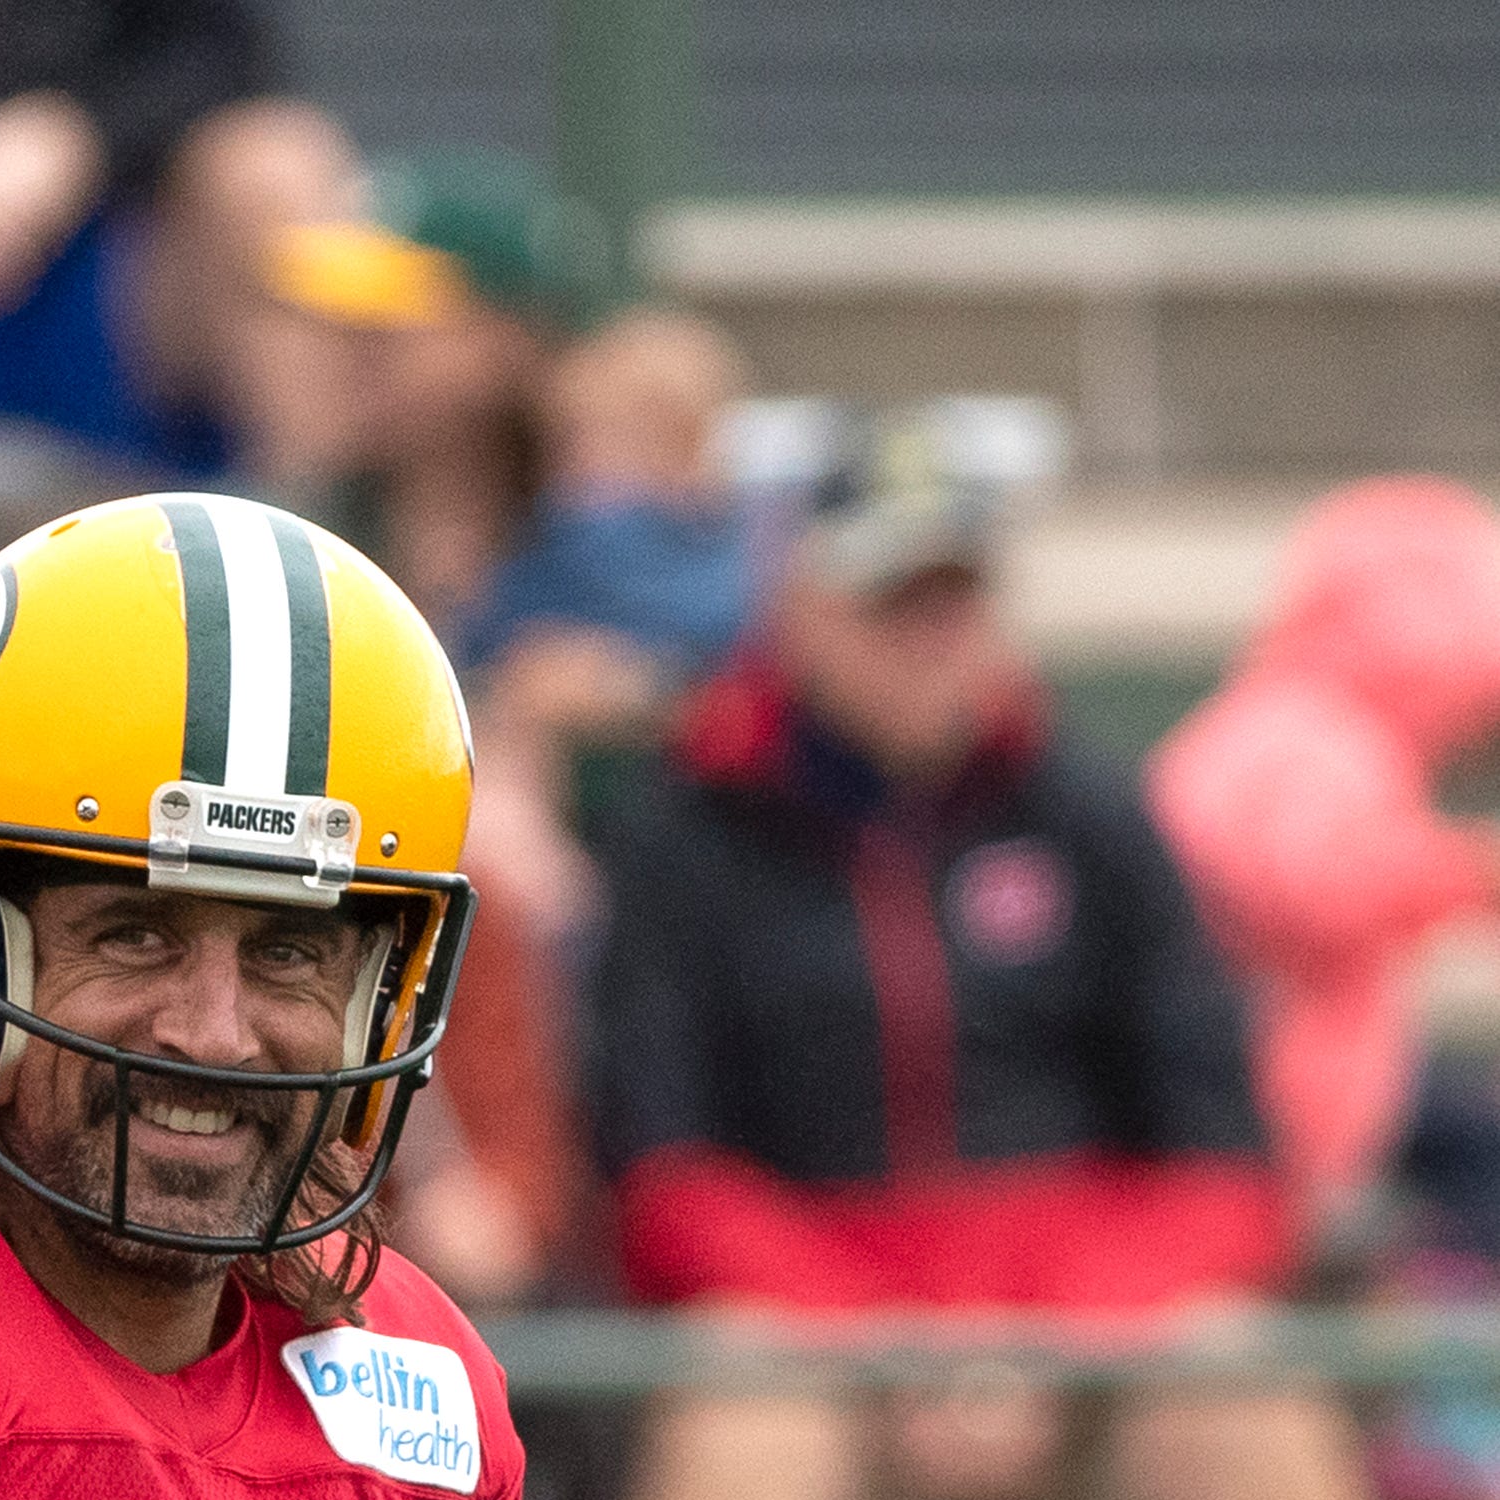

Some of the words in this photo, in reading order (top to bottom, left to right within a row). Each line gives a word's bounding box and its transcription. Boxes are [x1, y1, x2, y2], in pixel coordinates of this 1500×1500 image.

[206, 801, 296, 836] PACKERS
[299, 1348, 439, 1415] bellin
[378, 1407, 474, 1476] health
